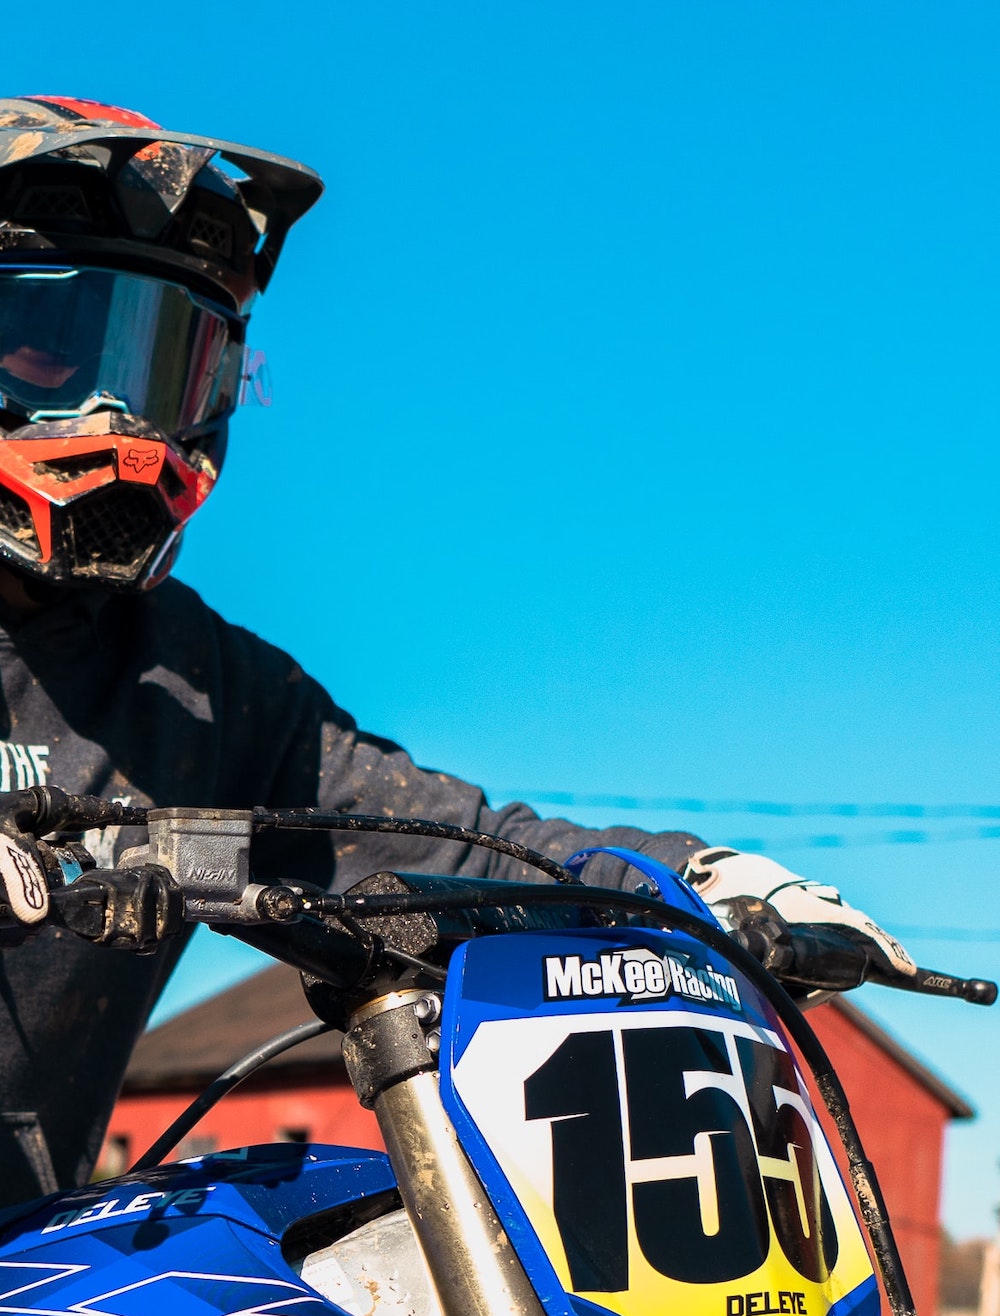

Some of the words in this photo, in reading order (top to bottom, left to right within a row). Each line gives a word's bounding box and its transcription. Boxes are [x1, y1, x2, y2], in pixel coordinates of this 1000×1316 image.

[546, 954, 666, 998] McKee
[667, 954, 742, 1011] Racing
[524, 1026, 839, 1293] 155
[41, 1186, 217, 1235] DELEYE
